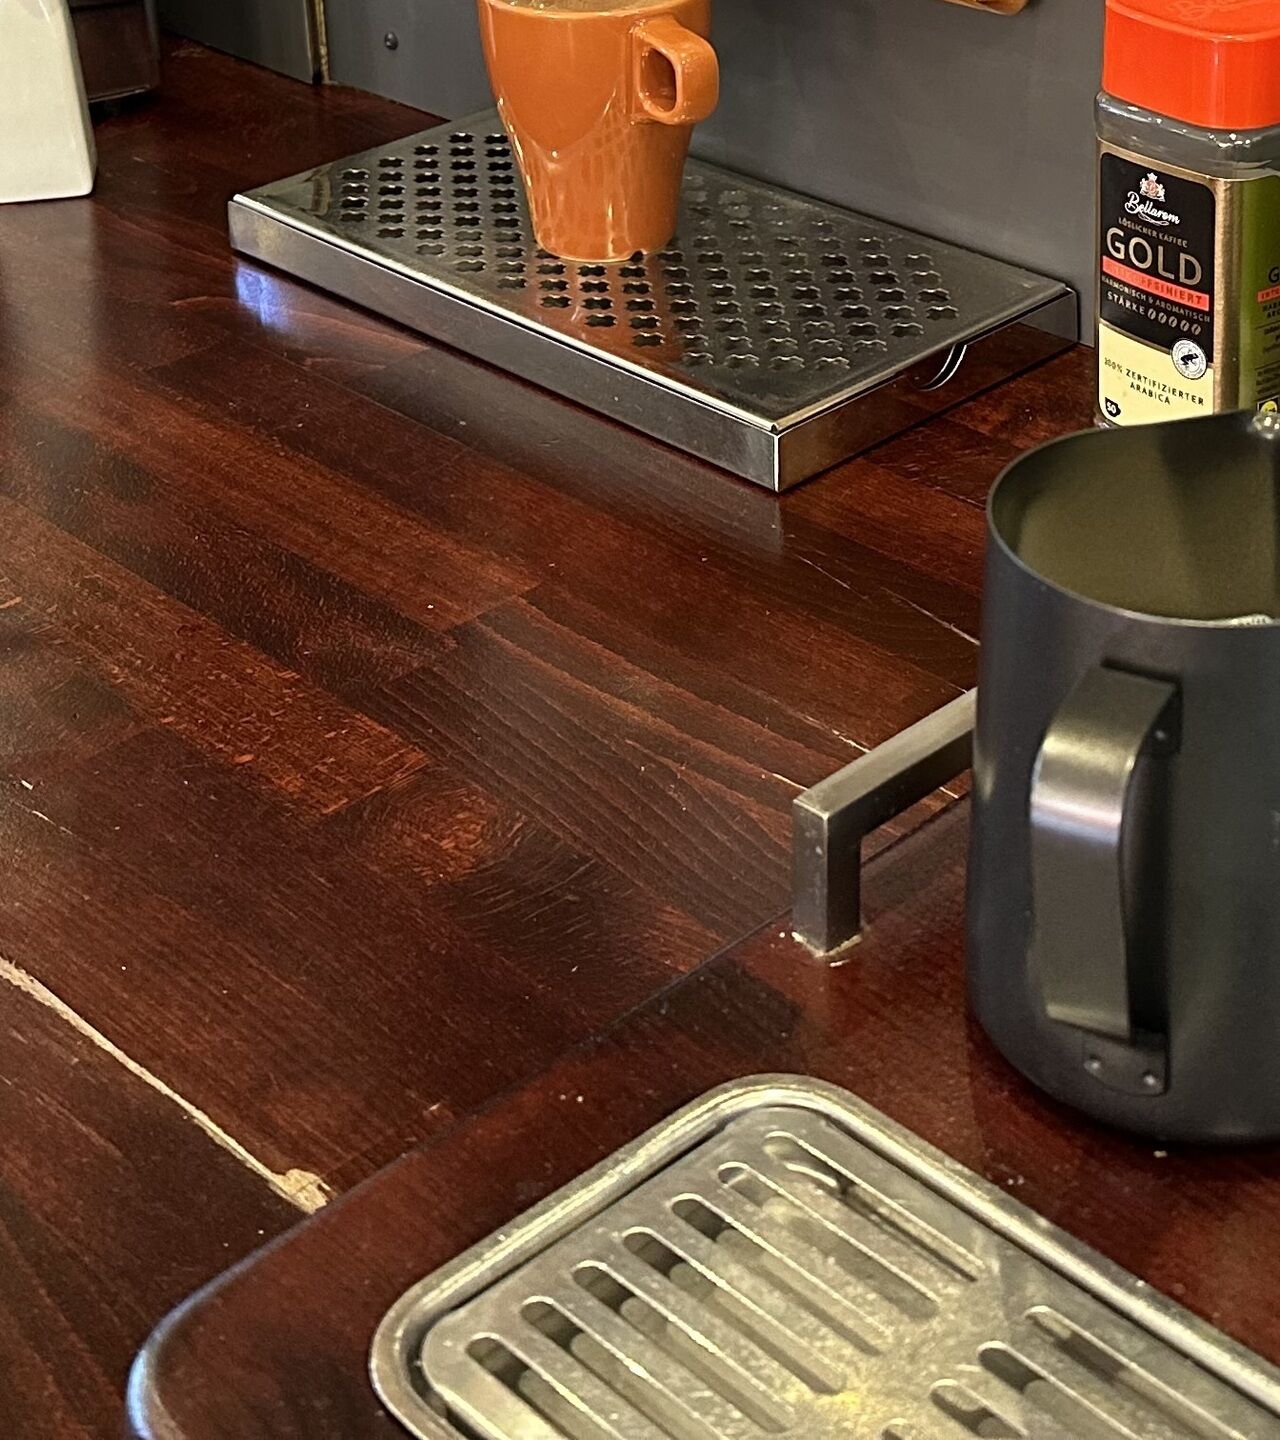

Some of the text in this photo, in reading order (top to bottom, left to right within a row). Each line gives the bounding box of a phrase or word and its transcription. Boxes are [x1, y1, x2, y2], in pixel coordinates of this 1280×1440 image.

[1124, 190, 1181, 226] Bellarom
[1106, 226, 1202, 286] GOLD
[1101, 275, 1147, 302] HARMONISCH
[1155, 300, 1211, 323] AROMATISCH
[1107, 291, 1146, 315] STÄRKE
[1125, 368, 1205, 406] ZERTIFIZIERTER
[1129, 381, 1171, 405] ARABICA
